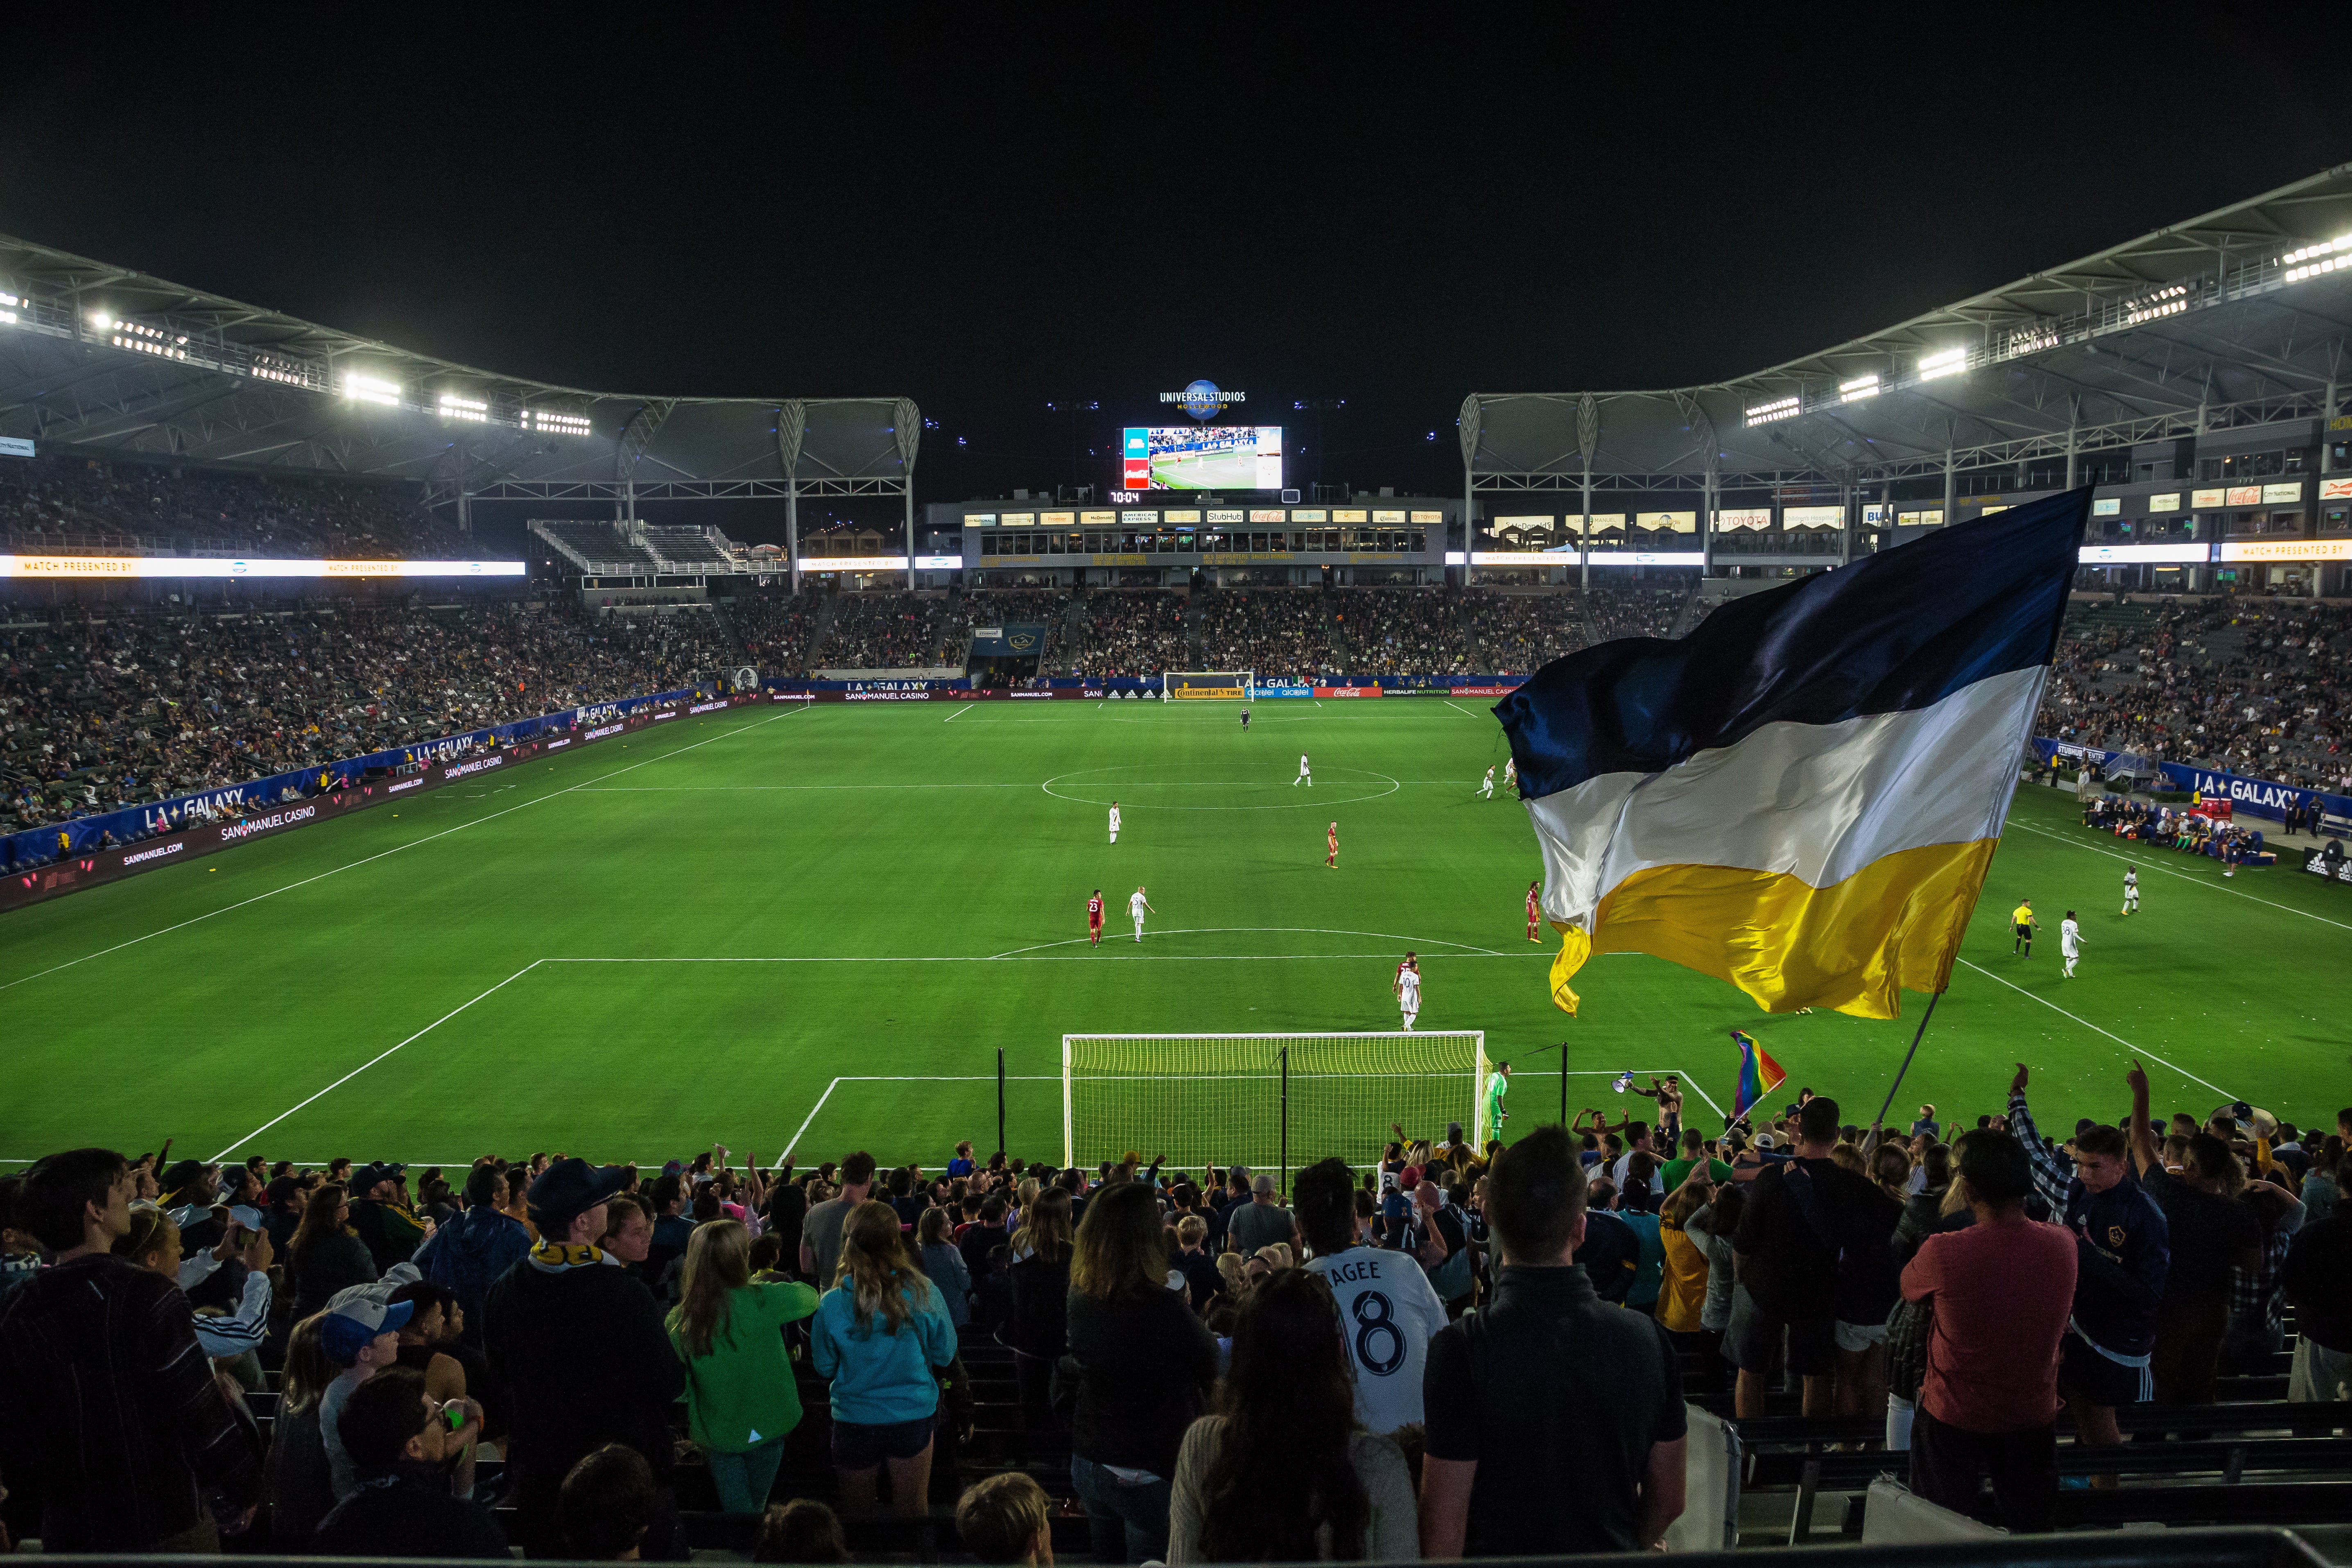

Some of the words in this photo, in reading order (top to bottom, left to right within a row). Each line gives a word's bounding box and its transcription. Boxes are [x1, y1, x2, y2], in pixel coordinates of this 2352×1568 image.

[1160, 392, 1208, 402] UNIVERSAL
[1210, 392, 1246, 401] STUDIOS
[1110, 492, 1139, 503] 70:04
[1727, 516, 1767, 525] TOYOTA
[1868, 512, 1891, 521] BU
[2276, 546, 2327, 555] PRESENTED
[2332, 545, 2343, 554] BY
[24, 563, 59, 571] MATCH
[64, 563, 118, 571] PRESENTED
[848, 683, 863, 691] LA
[1266, 679, 1318, 688] GAL
[1177, 688, 1218, 699] Continental
[2058, 745, 2083, 757] STUBHUB
[2087, 751, 2105, 760] ENTER
[445, 767, 457, 779] SAN
[461, 761, 484, 775] MANUEL
[483, 756, 502, 769] CASINO
[388, 778, 423, 793] SANMANUEL.COM
[2195, 773, 2214, 794] LA
[2231, 781, 2300, 810] GALAXY
[222, 827, 241, 841] SAN
[248, 815, 284, 833] MANUEL
[285, 805, 315, 823] CASINO
[124, 842, 183, 866] SANMANUEL.COM
[1089, 902, 1098, 912] 23
[1403, 977, 1410, 988] 10
[1383, 1175, 1393, 1188] 8
[1328, 1262, 1381, 1287] AGEE
[1352, 1290, 1407, 1377] 8
